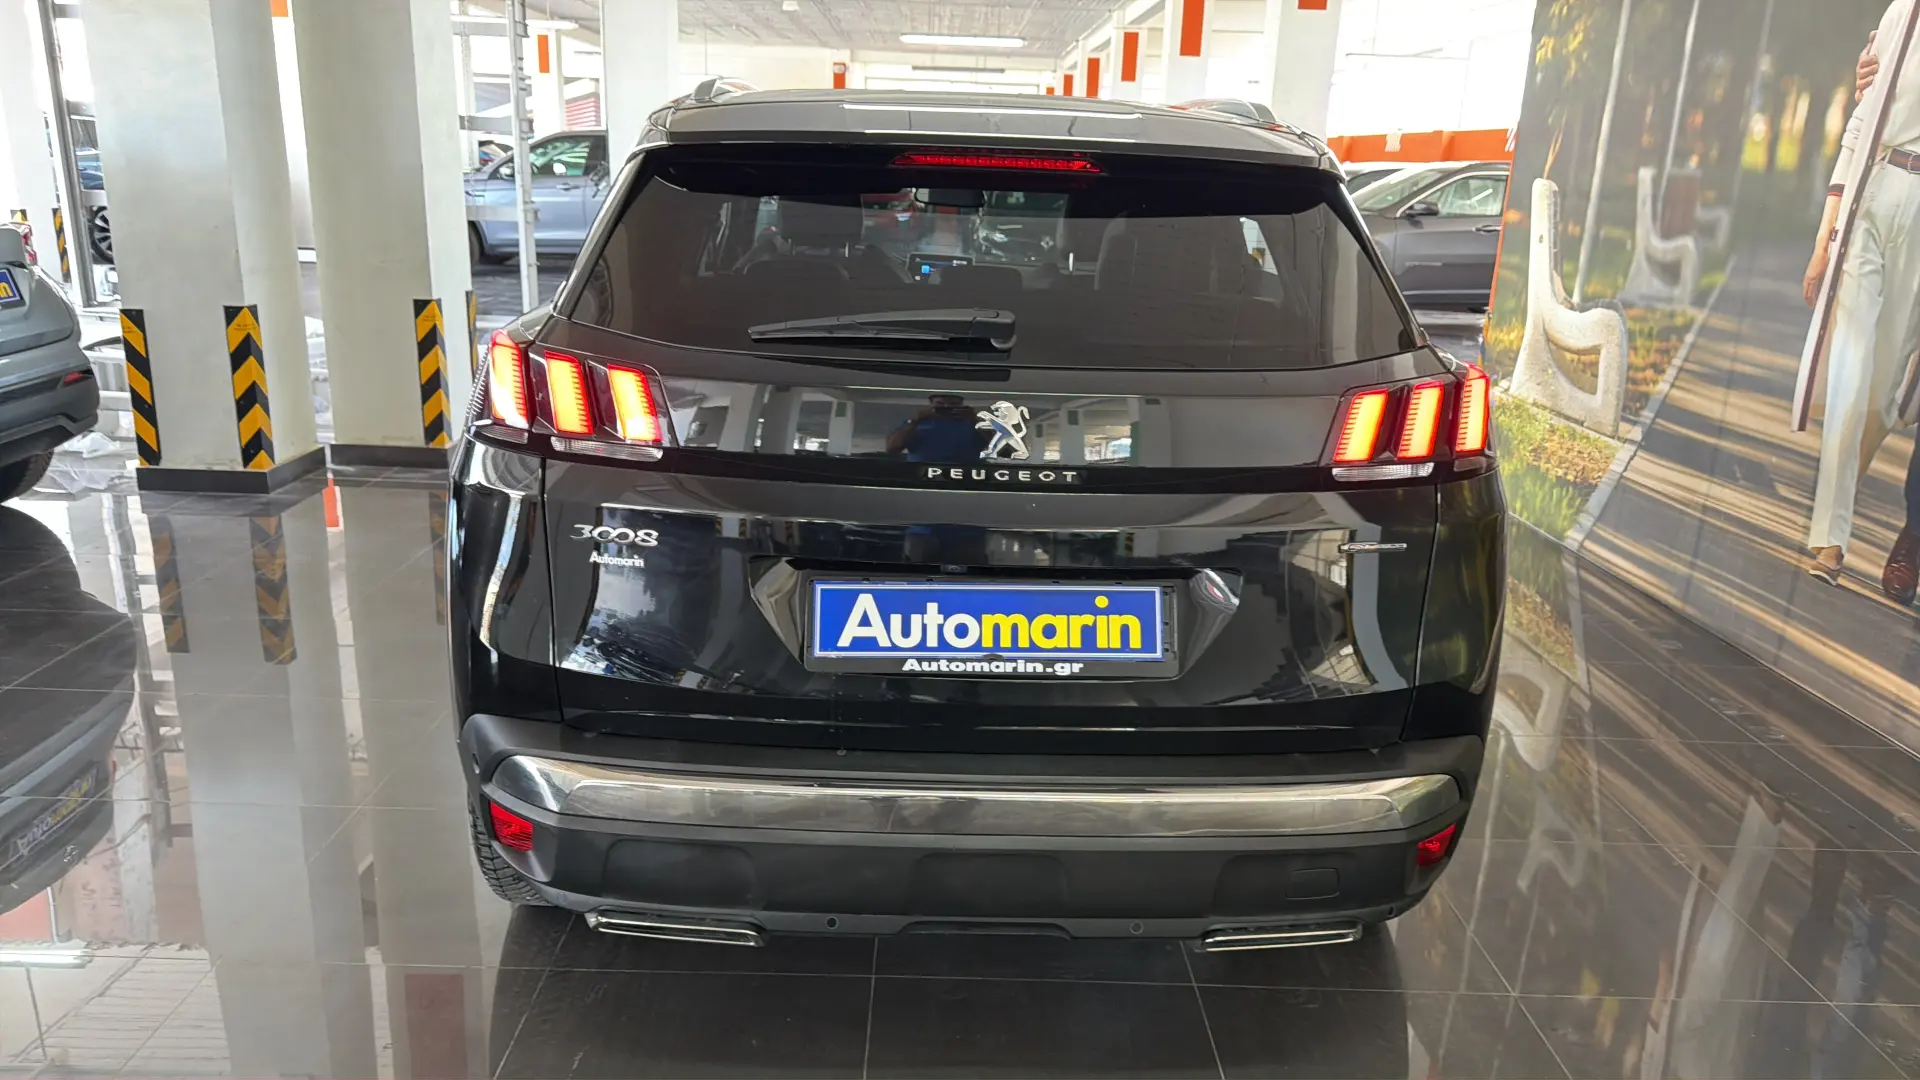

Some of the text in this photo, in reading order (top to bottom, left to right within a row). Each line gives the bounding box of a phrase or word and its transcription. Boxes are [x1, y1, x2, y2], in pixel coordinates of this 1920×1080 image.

[927, 467, 1077, 482] PEUGEOT
[569, 523, 659, 547] 3008
[589, 549, 645, 568] Automarin
[836, 593, 1142, 649] Automarin
[902, 658, 1084, 676] Automarin.gr
